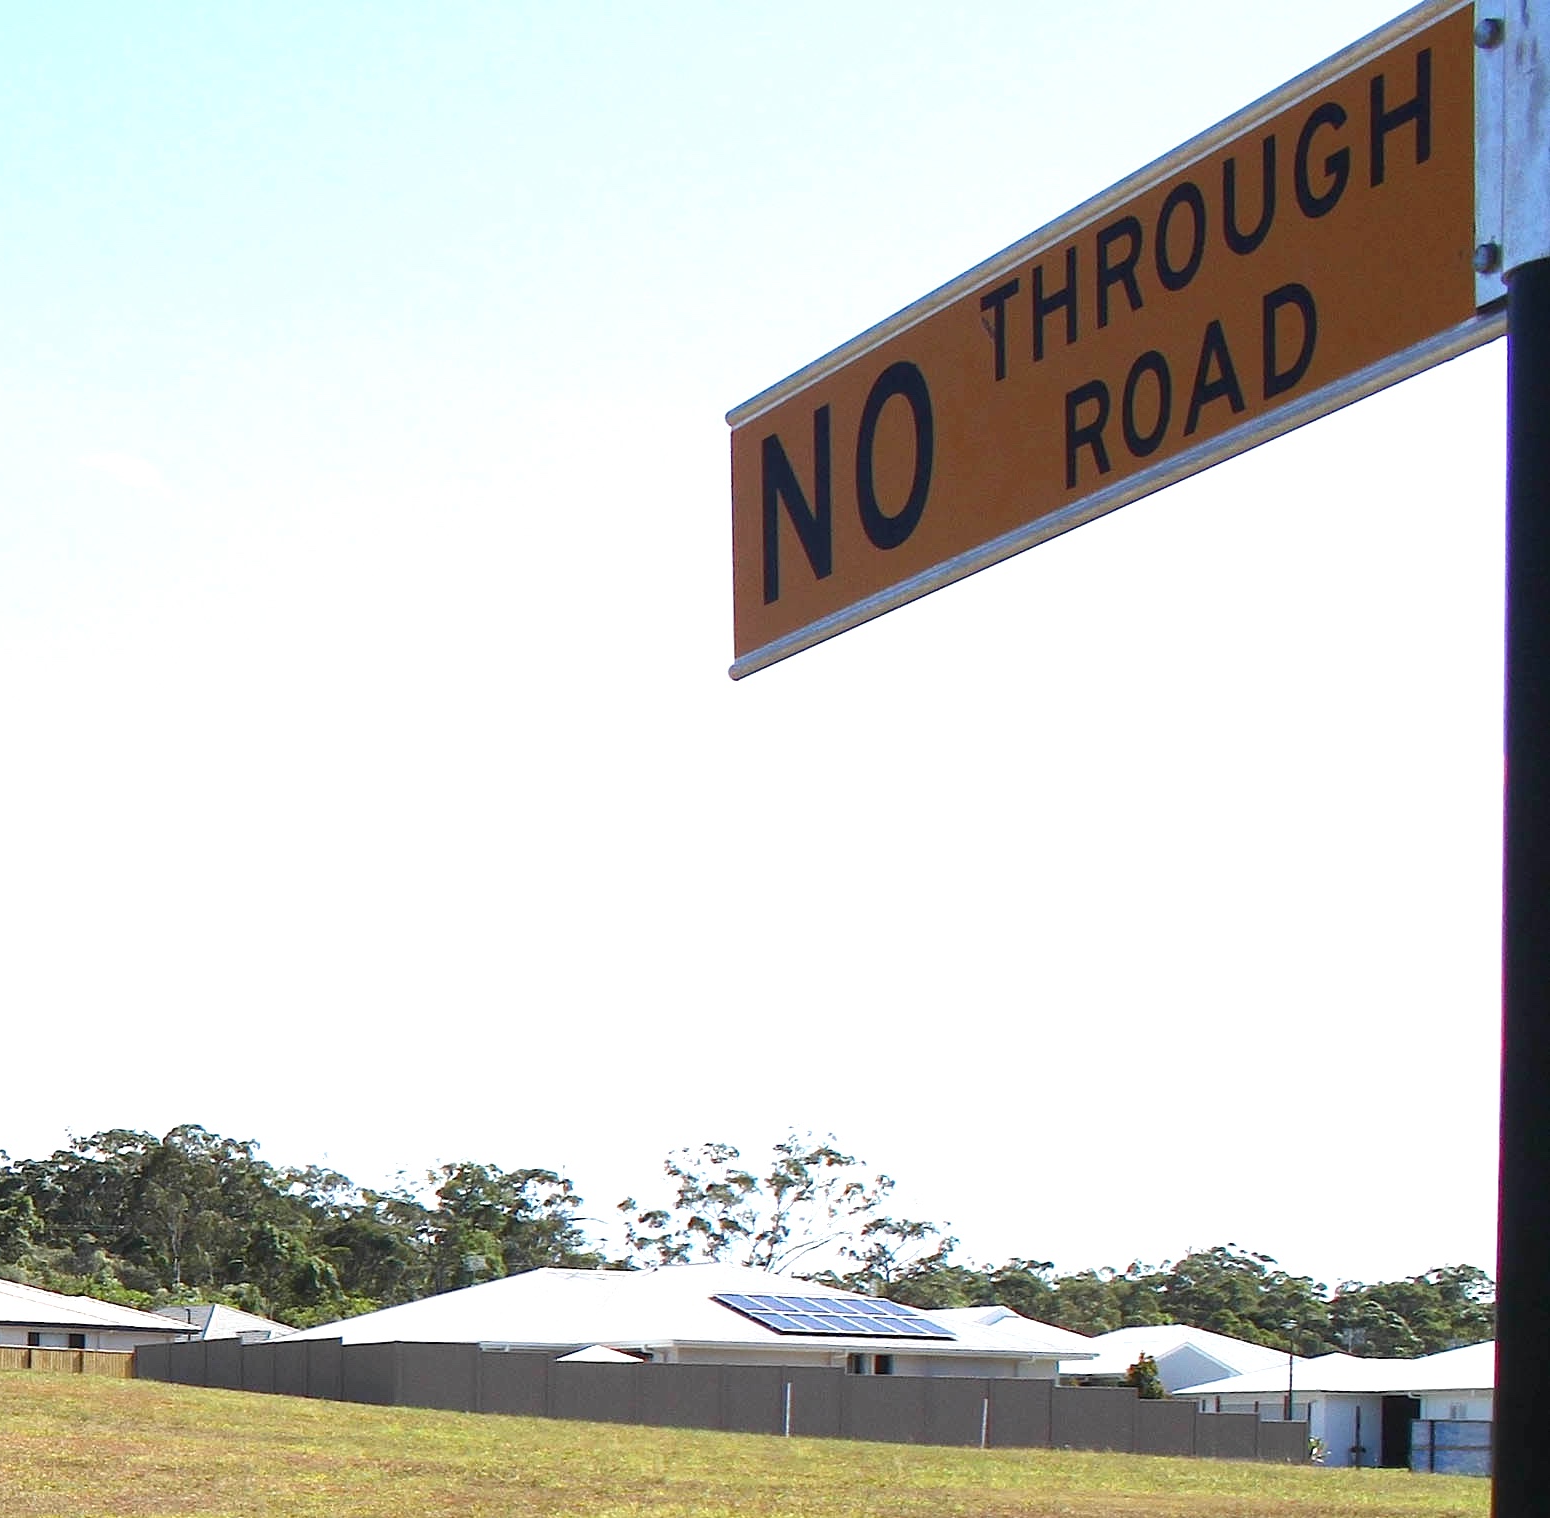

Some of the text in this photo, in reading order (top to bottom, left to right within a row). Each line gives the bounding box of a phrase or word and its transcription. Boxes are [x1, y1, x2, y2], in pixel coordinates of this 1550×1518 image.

[980, 47, 1432, 382] THROUGH
[761, 361, 934, 606] NO
[1065, 283, 1318, 490] ROAD
